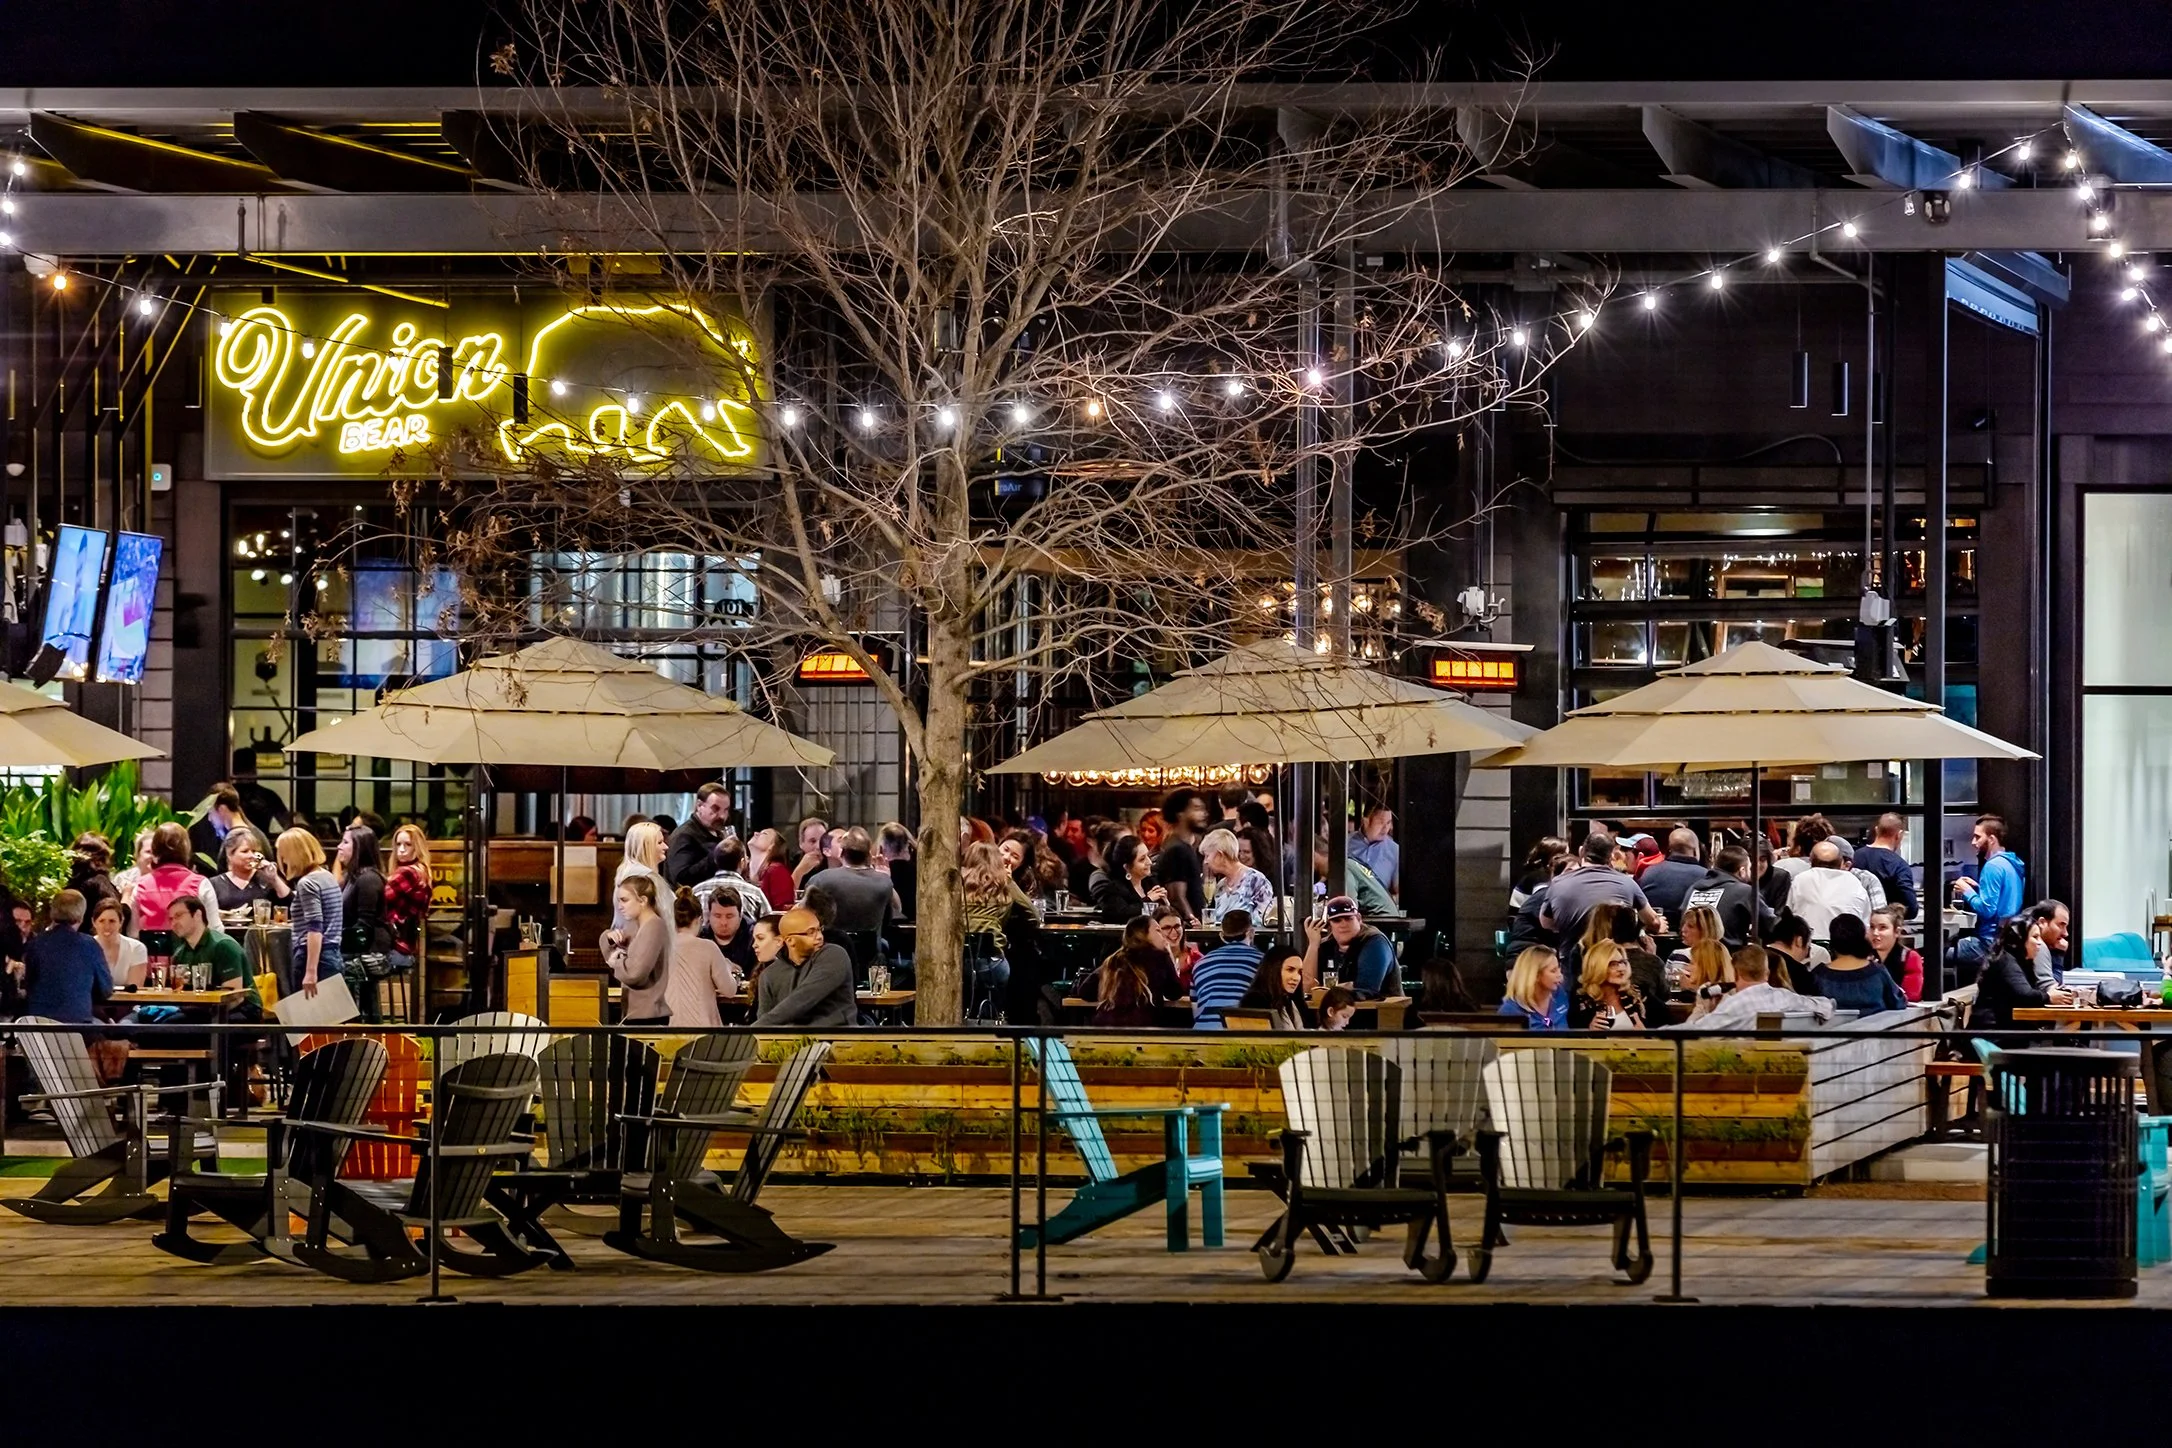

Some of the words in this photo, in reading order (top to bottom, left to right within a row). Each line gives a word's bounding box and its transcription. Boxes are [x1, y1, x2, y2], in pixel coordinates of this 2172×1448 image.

[215, 305, 507, 447] Union
[338, 413, 431, 454] BEAR
[721, 600, 743, 615] 101
